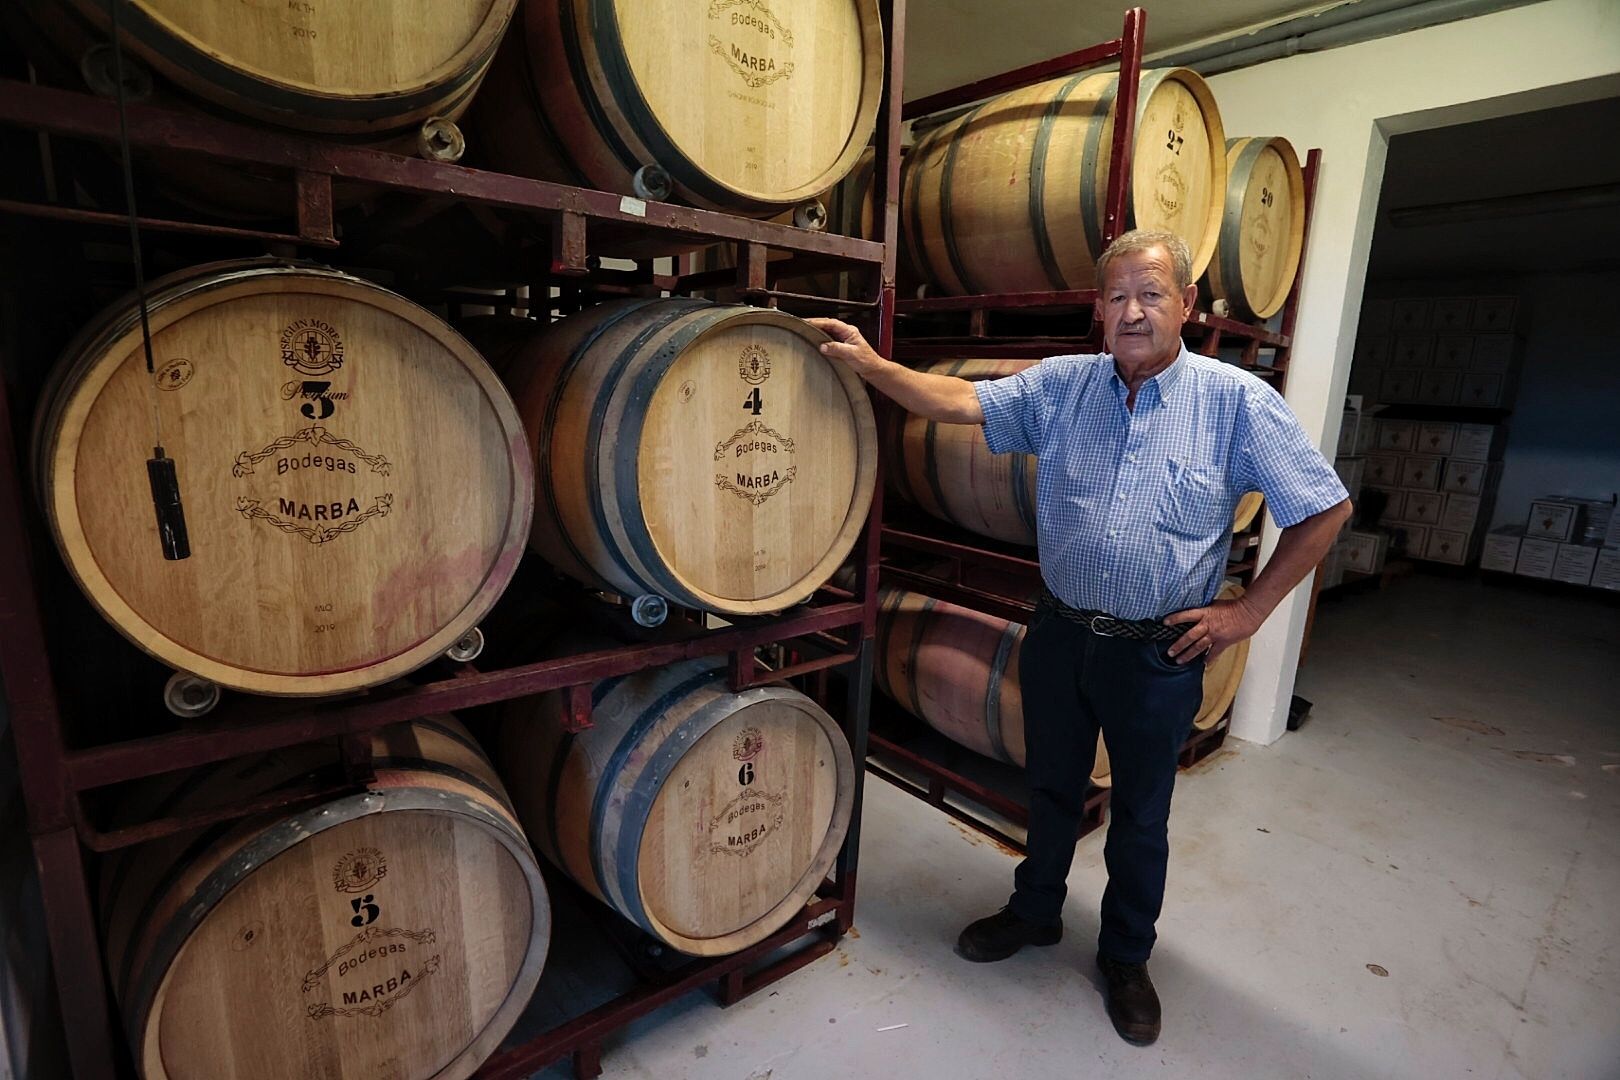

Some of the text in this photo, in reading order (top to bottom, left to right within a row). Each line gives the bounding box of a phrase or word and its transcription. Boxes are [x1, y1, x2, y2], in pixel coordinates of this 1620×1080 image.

[731, 12, 775, 40] Bodegas
[731, 43, 775, 72] MARBA
[1166, 129, 1184, 156] 27
[281, 318, 344, 354] SEGUIN MOREAU
[300, 381, 335, 420] 3
[742, 387, 763, 415] 4
[736, 440, 777, 458] Bodegas
[277, 452, 356, 475] Bodegas
[736, 470, 780, 489] MARBA
[279, 497, 360, 521] MARBA
[738, 762, 754, 786] 6
[727, 802, 765, 824] Bodegas
[728, 824, 766, 846] MARBA
[350, 894, 380, 928] 5
[338, 943, 406, 977] Bodegas
[342, 969, 412, 1005] MARBA
